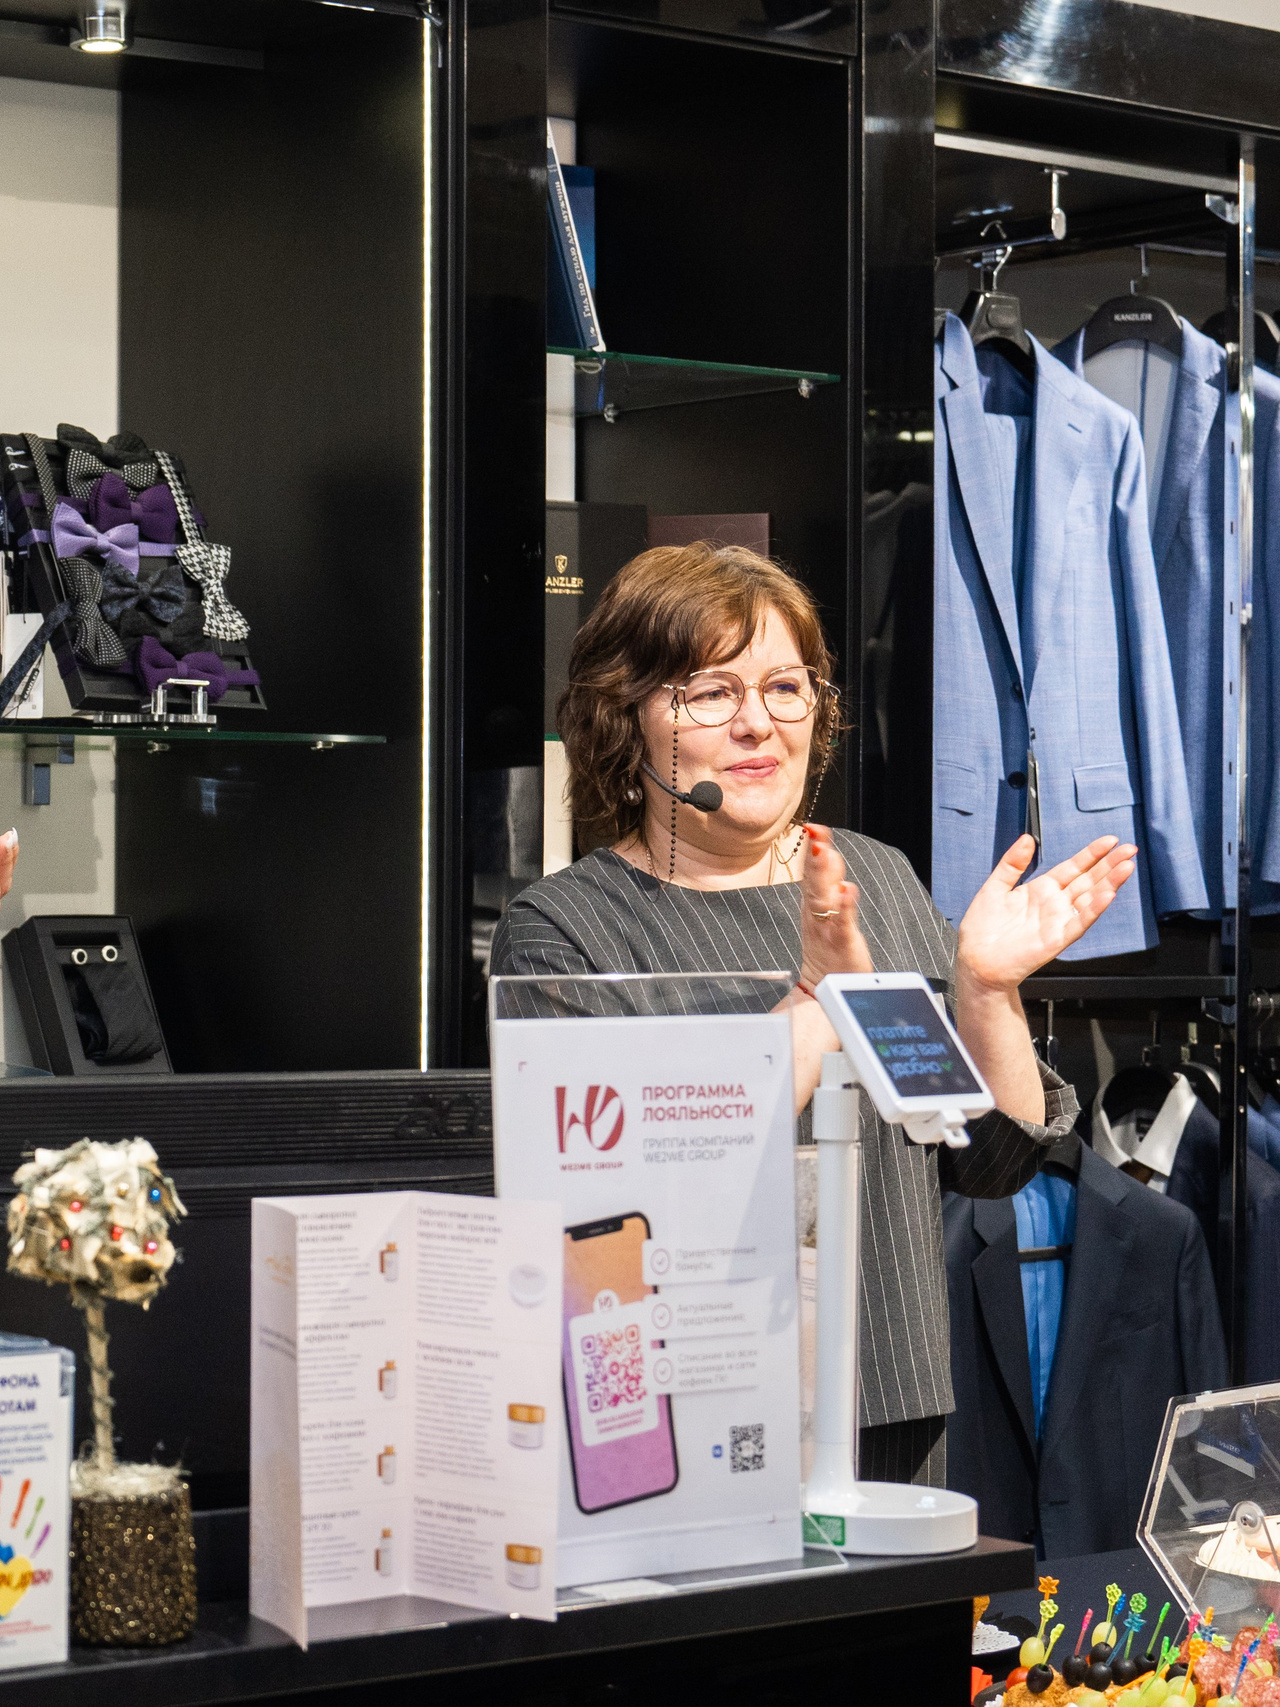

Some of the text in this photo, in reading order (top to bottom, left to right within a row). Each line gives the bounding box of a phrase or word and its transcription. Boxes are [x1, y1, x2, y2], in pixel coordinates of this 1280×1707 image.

[554, 181, 592, 318] Гид по стилю для мужчин
[545, 576, 584, 588] ANZLER
[642, 1084, 746, 1101] ПРОГРАММА
[642, 1103, 754, 1123] ЛОЯЛЬНОСТИ
[642, 1133, 755, 1150] ГРУППА КОМПАНИЙ
[642, 1149, 726, 1163] WE2WE GROUP
